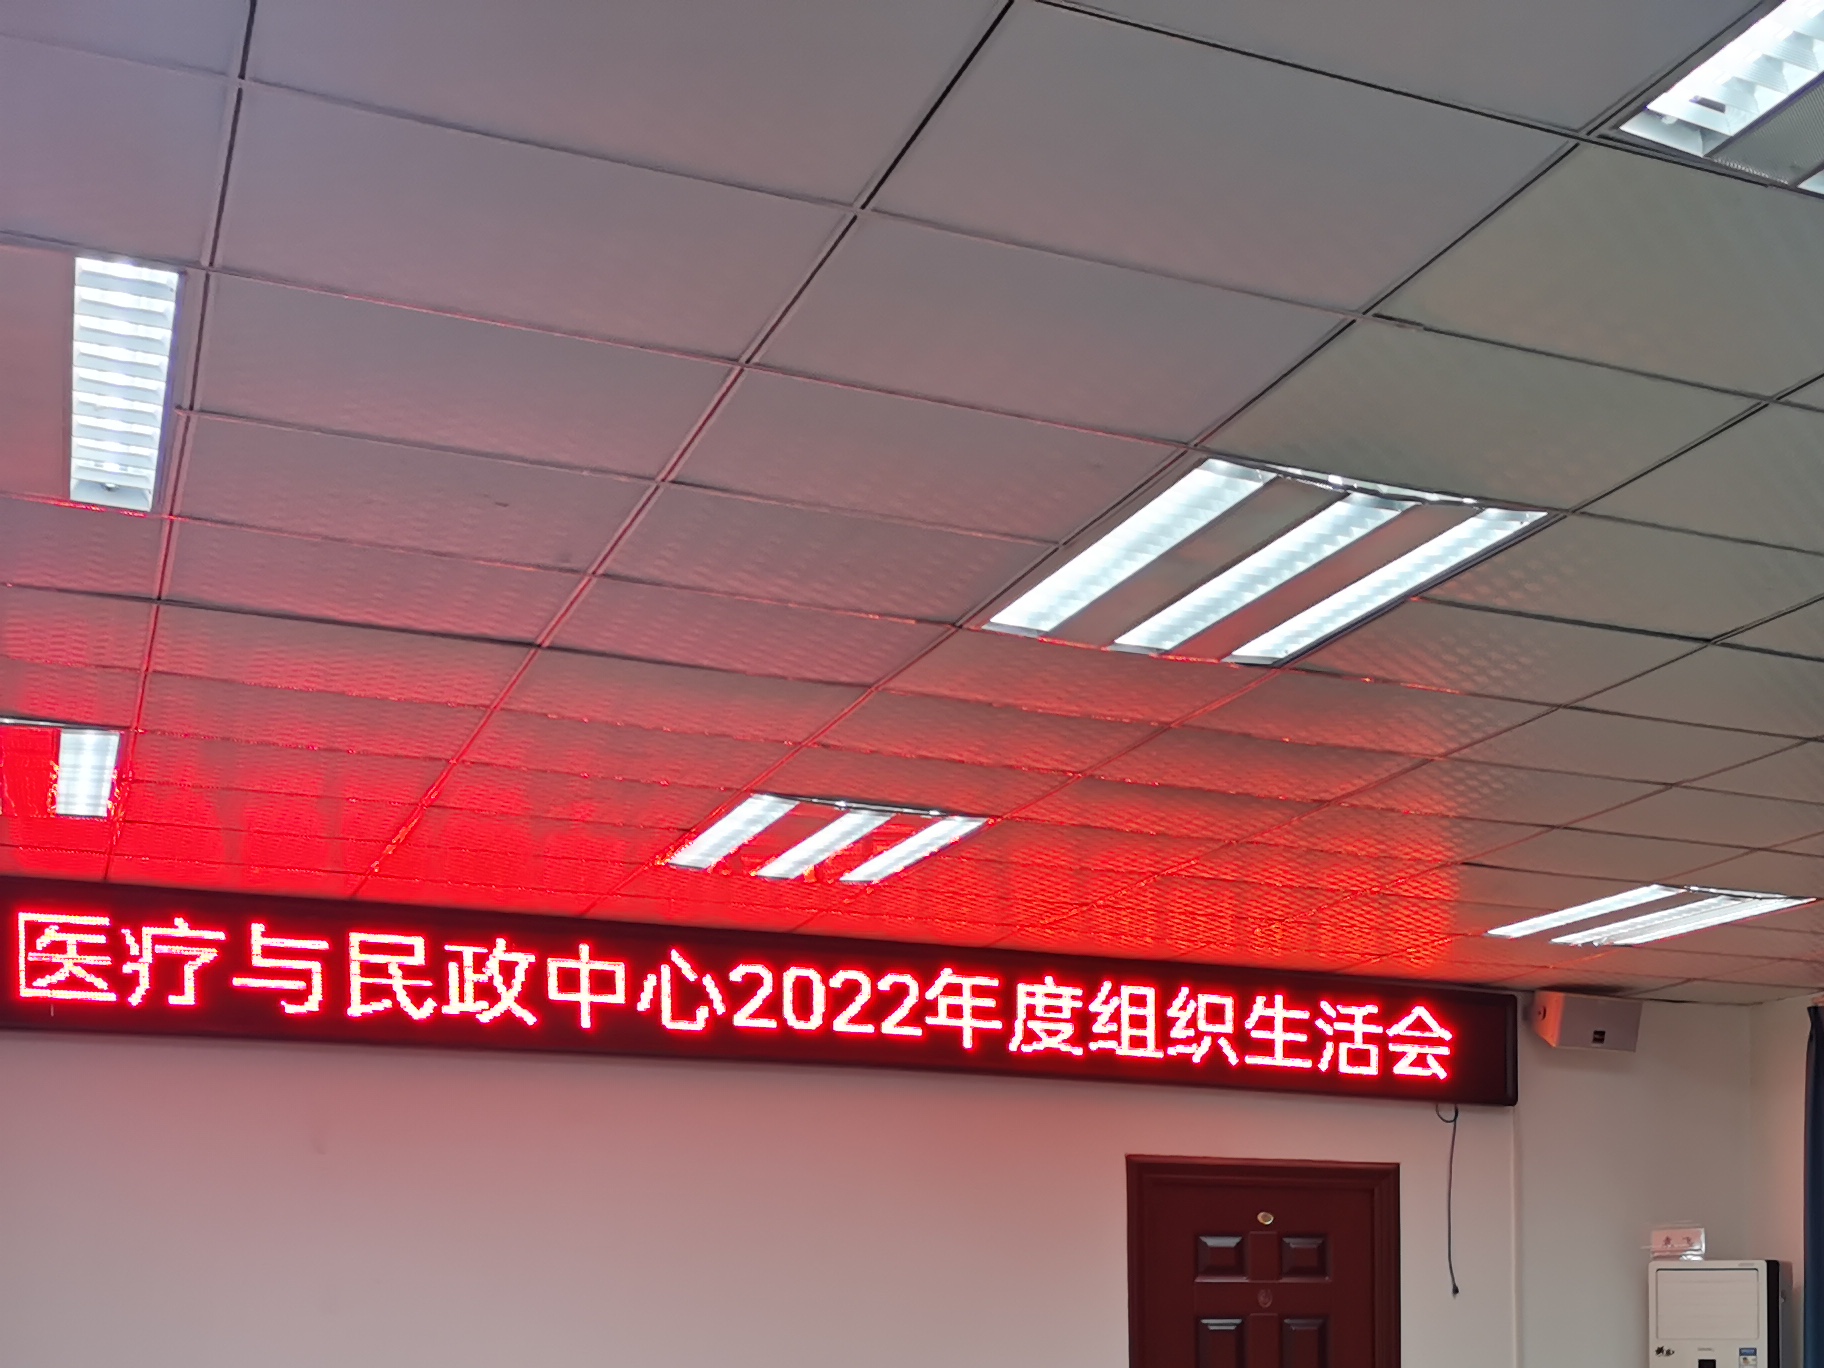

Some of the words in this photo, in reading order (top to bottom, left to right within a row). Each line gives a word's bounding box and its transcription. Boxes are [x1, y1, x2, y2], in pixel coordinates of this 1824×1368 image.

[16, 911, 1454, 1082] 医疗与民政中心2022年度组织生活会
